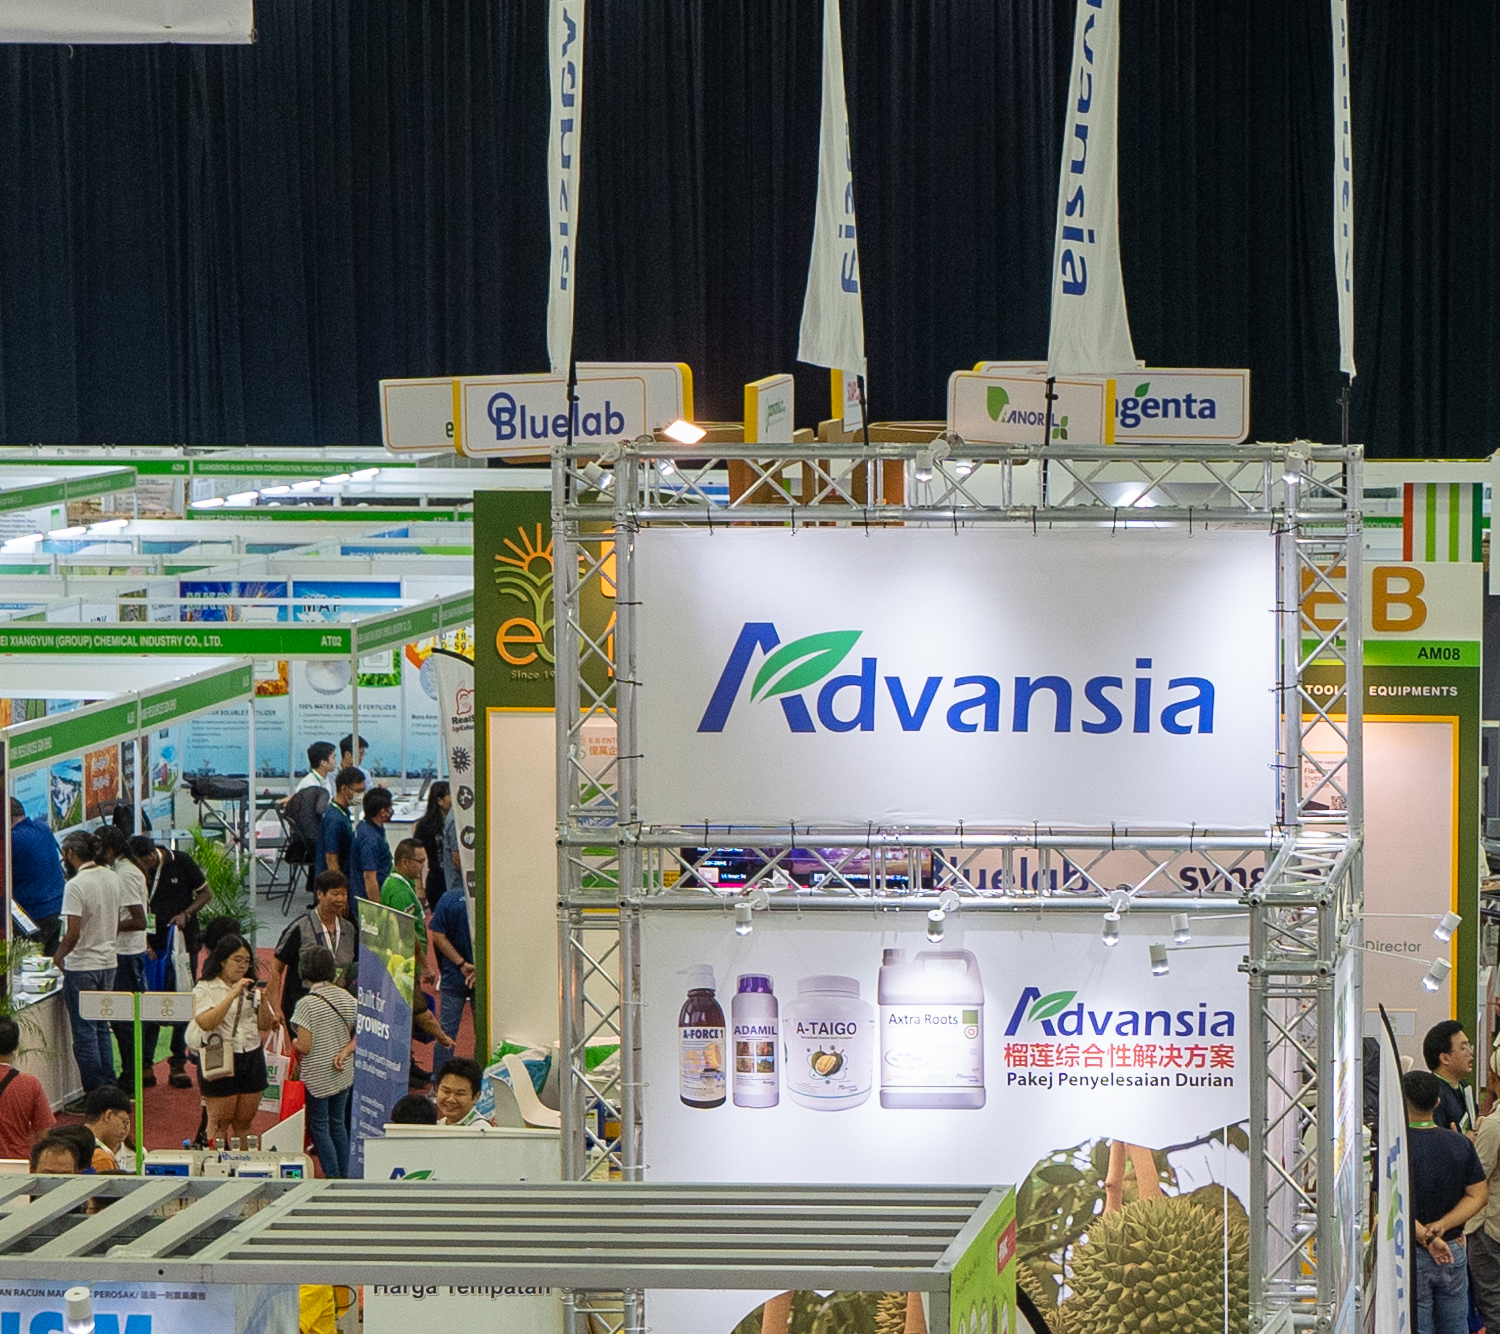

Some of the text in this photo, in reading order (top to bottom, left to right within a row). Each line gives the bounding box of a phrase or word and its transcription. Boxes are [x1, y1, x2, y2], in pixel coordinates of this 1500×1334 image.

[488, 392, 625, 441] Bluelab
[9, 635, 53, 647] XIANGYUN
[55, 635, 93, 649] (GROUP)
[94, 635, 138, 647] CHEMICAL
[139, 635, 183, 647] INDUSTRY
[203, 636, 223, 647] LTD.
[321, 635, 342, 647] AT02
[1417, 648, 1461, 661] AM08
[697, 622, 1216, 735] Advansia
[1369, 686, 1458, 698] EQUIPMENTS
[1365, 939, 1422, 953] Director
[1003, 986, 1235, 1038] Advansia
[888, 1013, 959, 1026] Axtra Roots
[733, 1025, 778, 1036] ADAMIL
[796, 1021, 857, 1037] A-TAIGO
[1003, 1042, 1236, 1069] 榴莲综合性解决方案
[1006, 1071, 1235, 1091] Pakej Penyelesaian Durian
